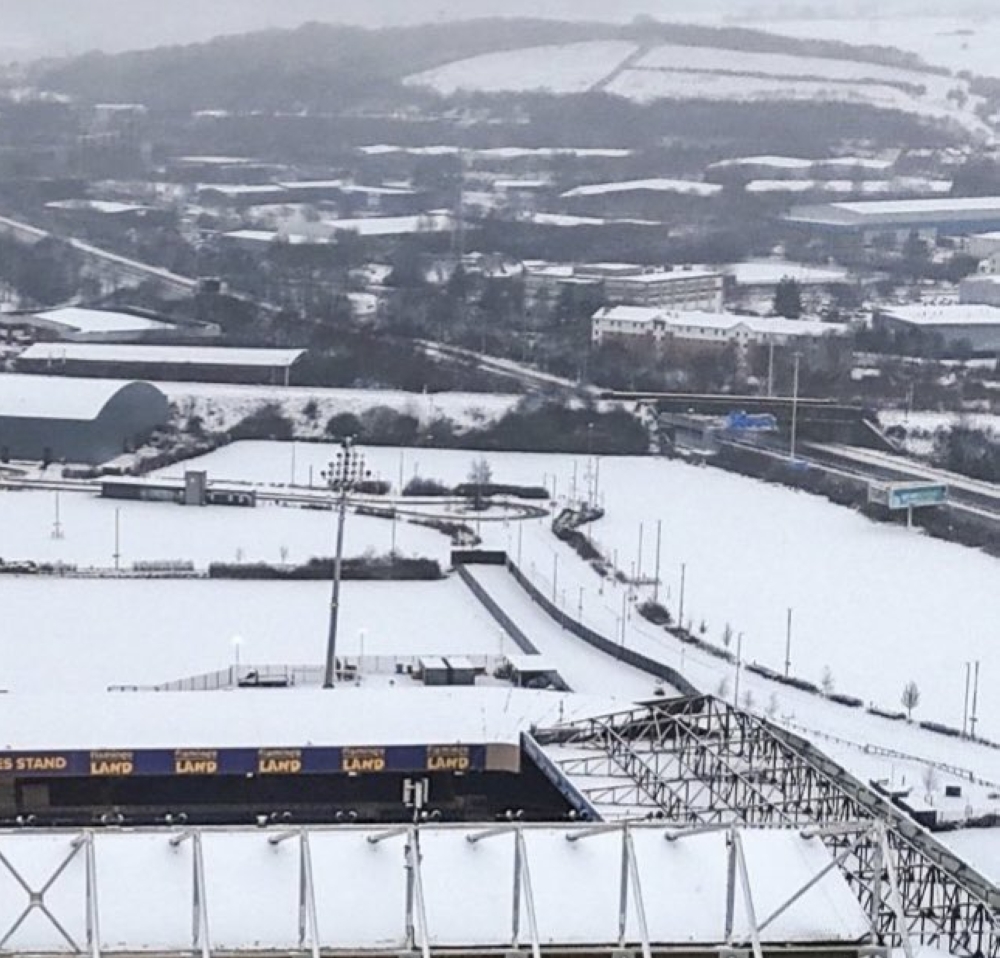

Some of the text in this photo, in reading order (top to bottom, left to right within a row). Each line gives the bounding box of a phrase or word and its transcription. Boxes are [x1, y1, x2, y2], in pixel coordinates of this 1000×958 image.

[16, 757, 67, 770] STAND
[90, 761, 133, 775] LAND
[175, 760, 217, 774] LAND
[259, 760, 302, 773] LAND
[342, 757, 385, 770] LAND
[427, 756, 469, 770] LAND
